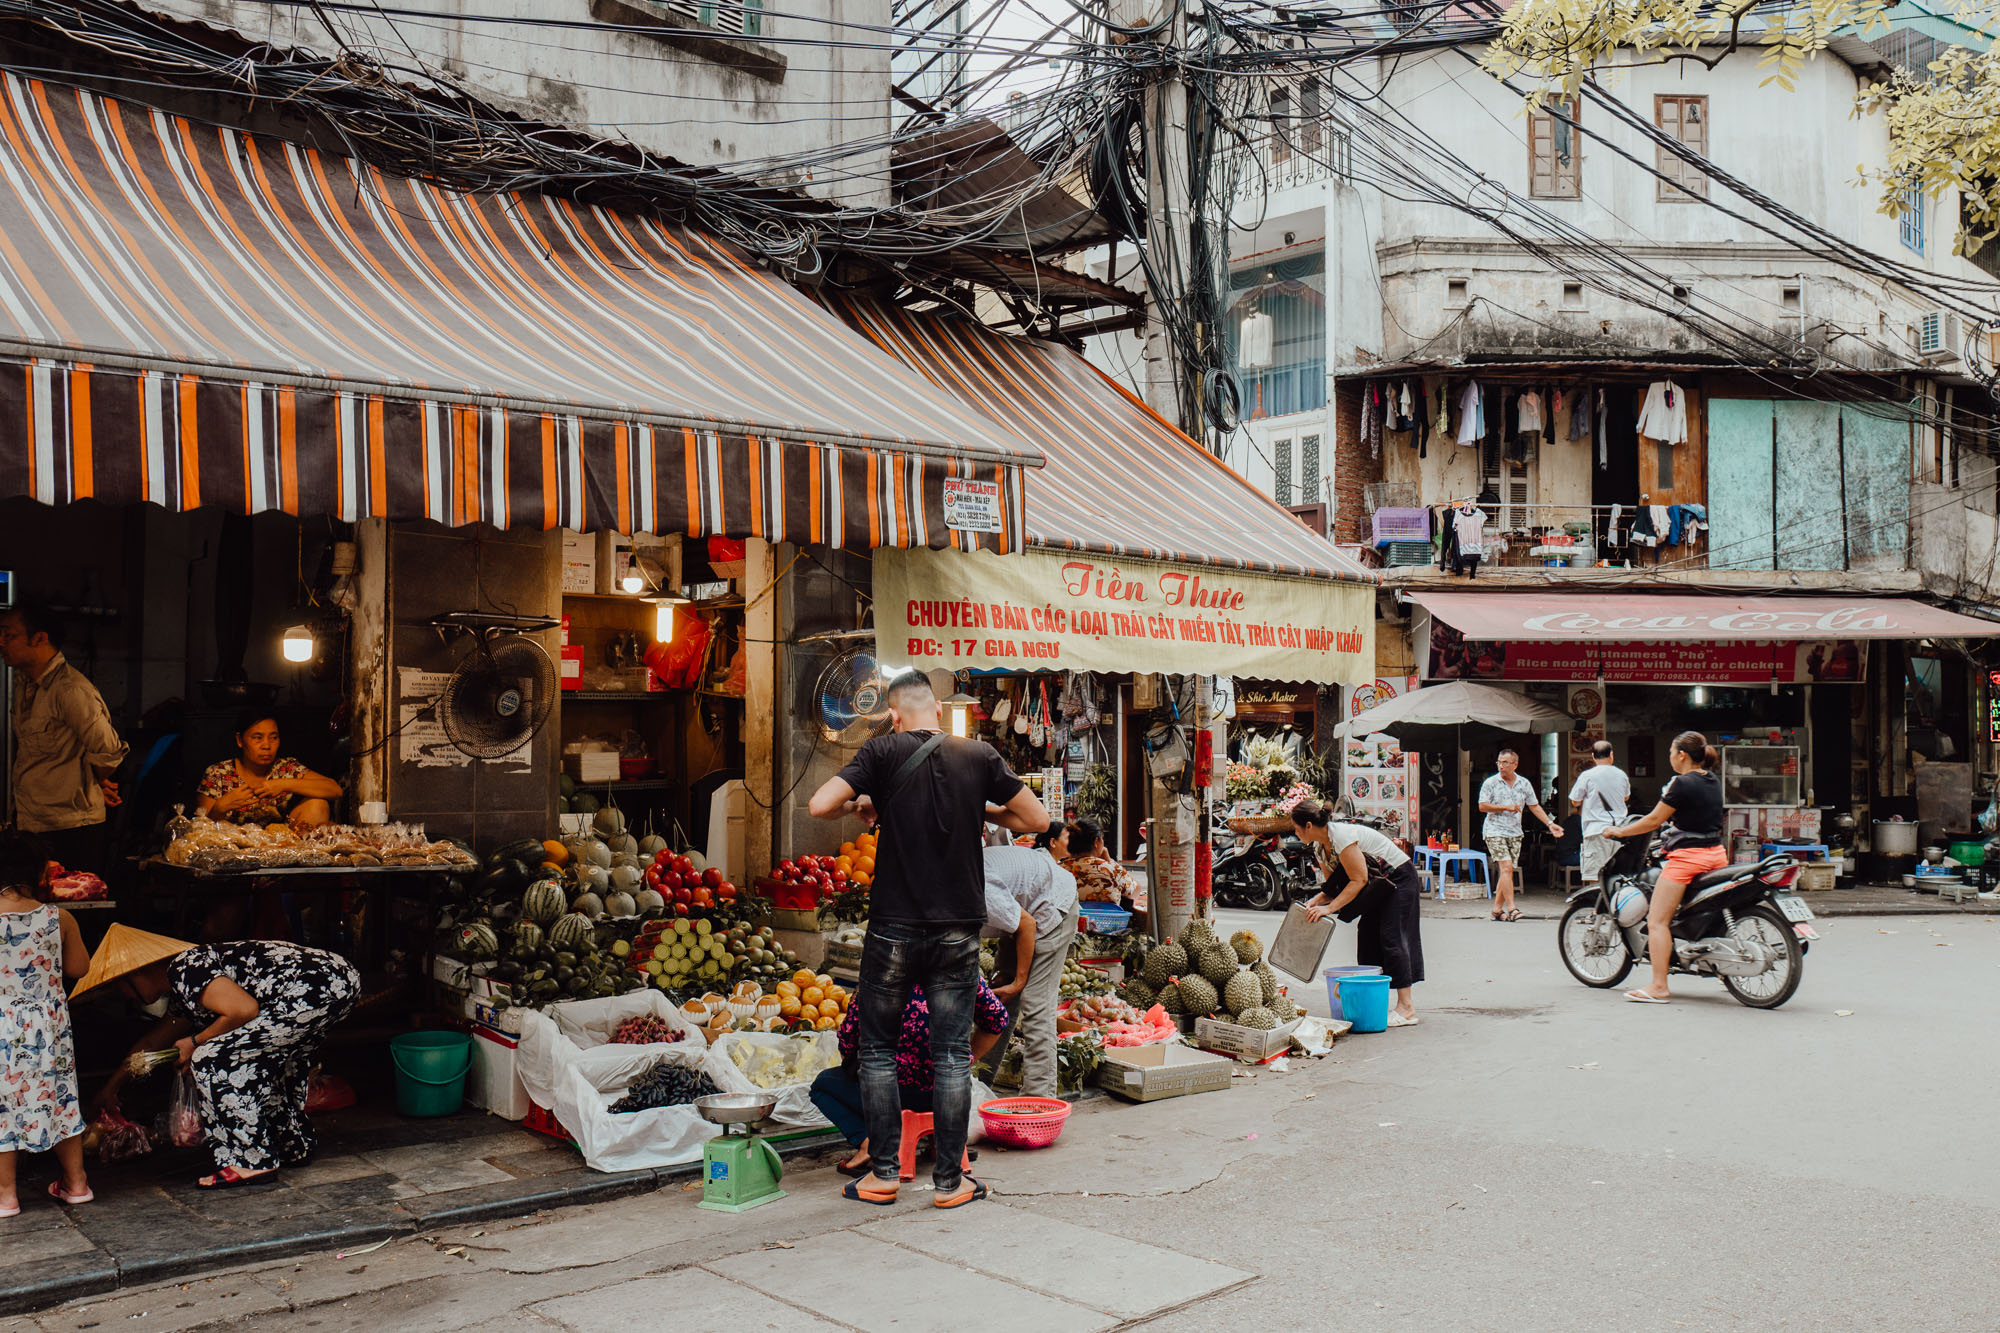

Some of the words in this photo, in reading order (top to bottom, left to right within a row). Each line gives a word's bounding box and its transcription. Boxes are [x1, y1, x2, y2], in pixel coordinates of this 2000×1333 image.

[945, 480, 963, 491] PHÚ
[966, 482, 996, 496] THÀNH
[1062, 562, 1148, 601] Tiền
[1159, 572, 1245, 616] Thực
[907, 597, 987, 628] CHUYÊN
[991, 601, 1029, 631] BÁN
[1031, 603, 1066, 633] CÁC
[1071, 610, 1108, 640] LOẠI
[1111, 610, 1146, 638] TRÁI
[1148, 612, 1174, 640] CÂY
[1178, 613, 1216, 643] MIỀN
[1217, 618, 1245, 647] TÂY,
[1246, 621, 1276, 647] TRÁI
[1278, 623, 1301, 649] CÂY
[1305, 626, 1334, 655] NHẬP
[1336, 625, 1363, 654] KHẨU
[1522, 606, 1898, 634] Coca-Cola
[907, 638, 943, 656] ĐC:
[951, 639, 977, 656] 17
[984, 639, 1018, 657] GIA
[1022, 641, 1060, 658] NGƯ
[1517, 659, 1548, 668] Rice
[1552, 659, 1600, 668] noodle
[1604, 660, 1638, 670] soup
[1642, 660, 1672, 669] with
[1677, 660, 1706, 669] beef
[1711, 662, 1725, 670] or
[1729, 661, 1784, 670] chicken
[1269, 691, 1298, 703] Maker
